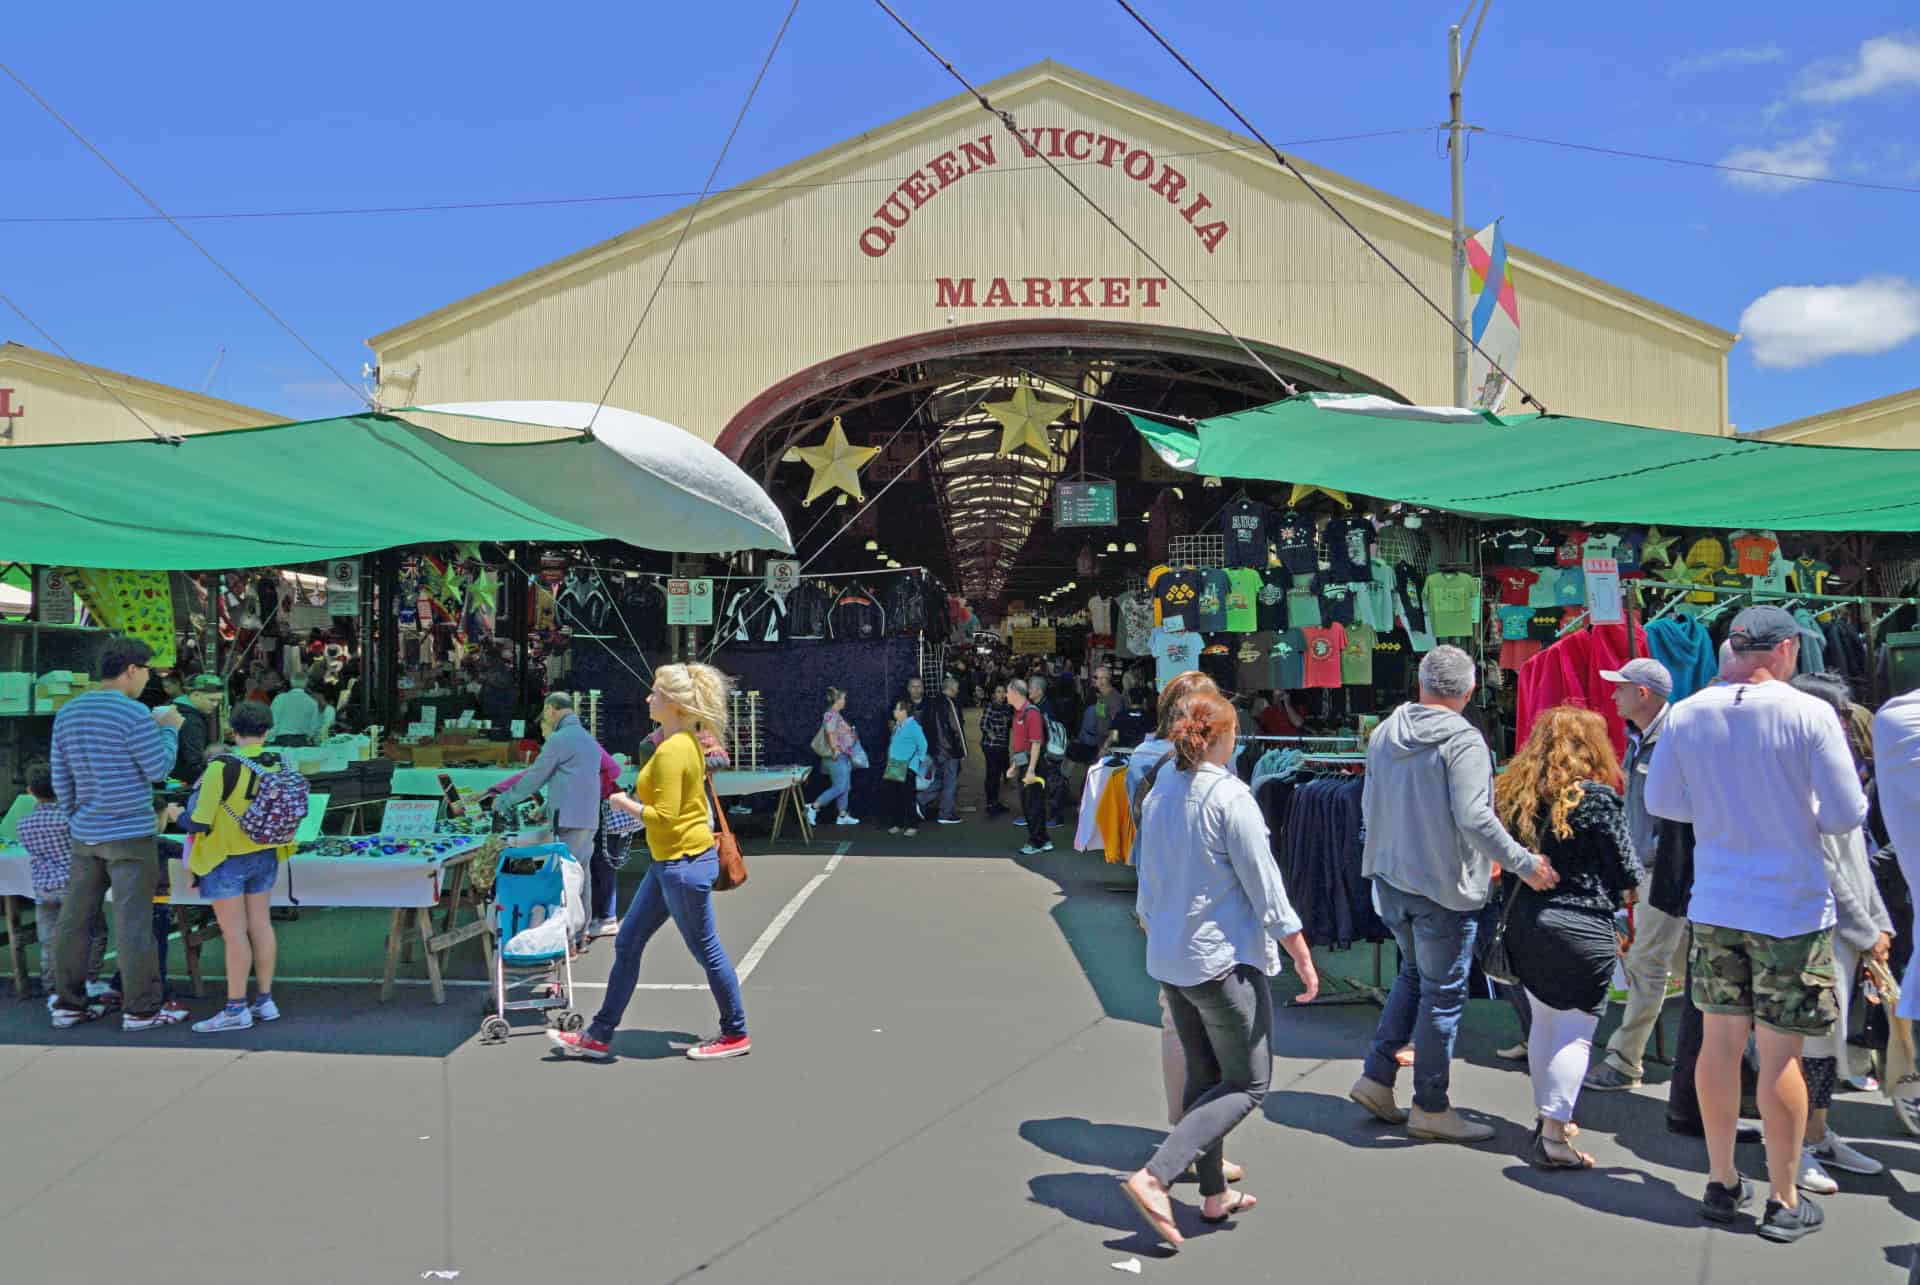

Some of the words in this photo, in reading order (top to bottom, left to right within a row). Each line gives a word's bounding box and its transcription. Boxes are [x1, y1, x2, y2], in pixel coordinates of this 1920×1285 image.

[859, 135, 998, 258] QUEEN
[1011, 127, 1230, 254] VICTORIA
[935, 277, 1167, 308] MARKET
